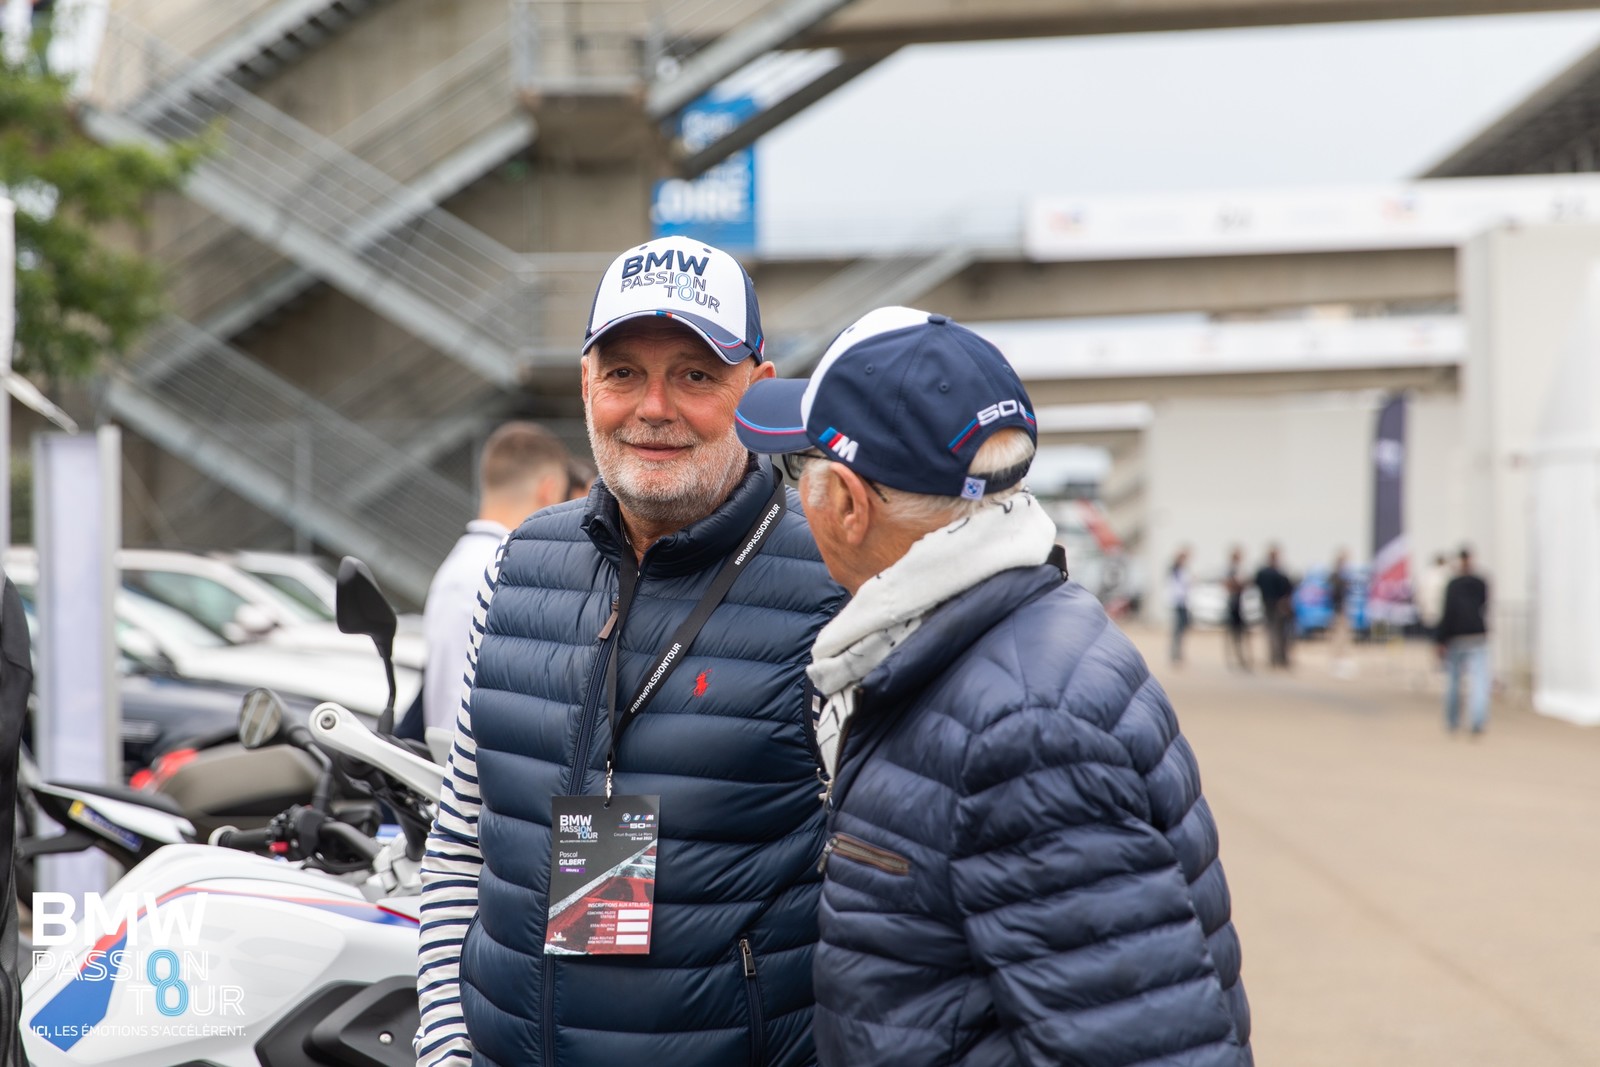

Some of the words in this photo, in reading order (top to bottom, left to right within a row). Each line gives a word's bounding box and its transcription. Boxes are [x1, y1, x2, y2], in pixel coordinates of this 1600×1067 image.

[621, 249, 709, 280] BMW
[620, 271, 707, 292] PASSION
[664, 284, 721, 314] TOUR
[735, 503, 781, 566] #BMWPASSIONTOUR
[630, 642, 682, 714] #BMWPASSIONTOUR
[559, 814, 592, 826] BMW
[559, 825, 592, 833] PASSION
[577, 832, 599, 840] TOUR
[558, 858, 587, 866] GILBERT
